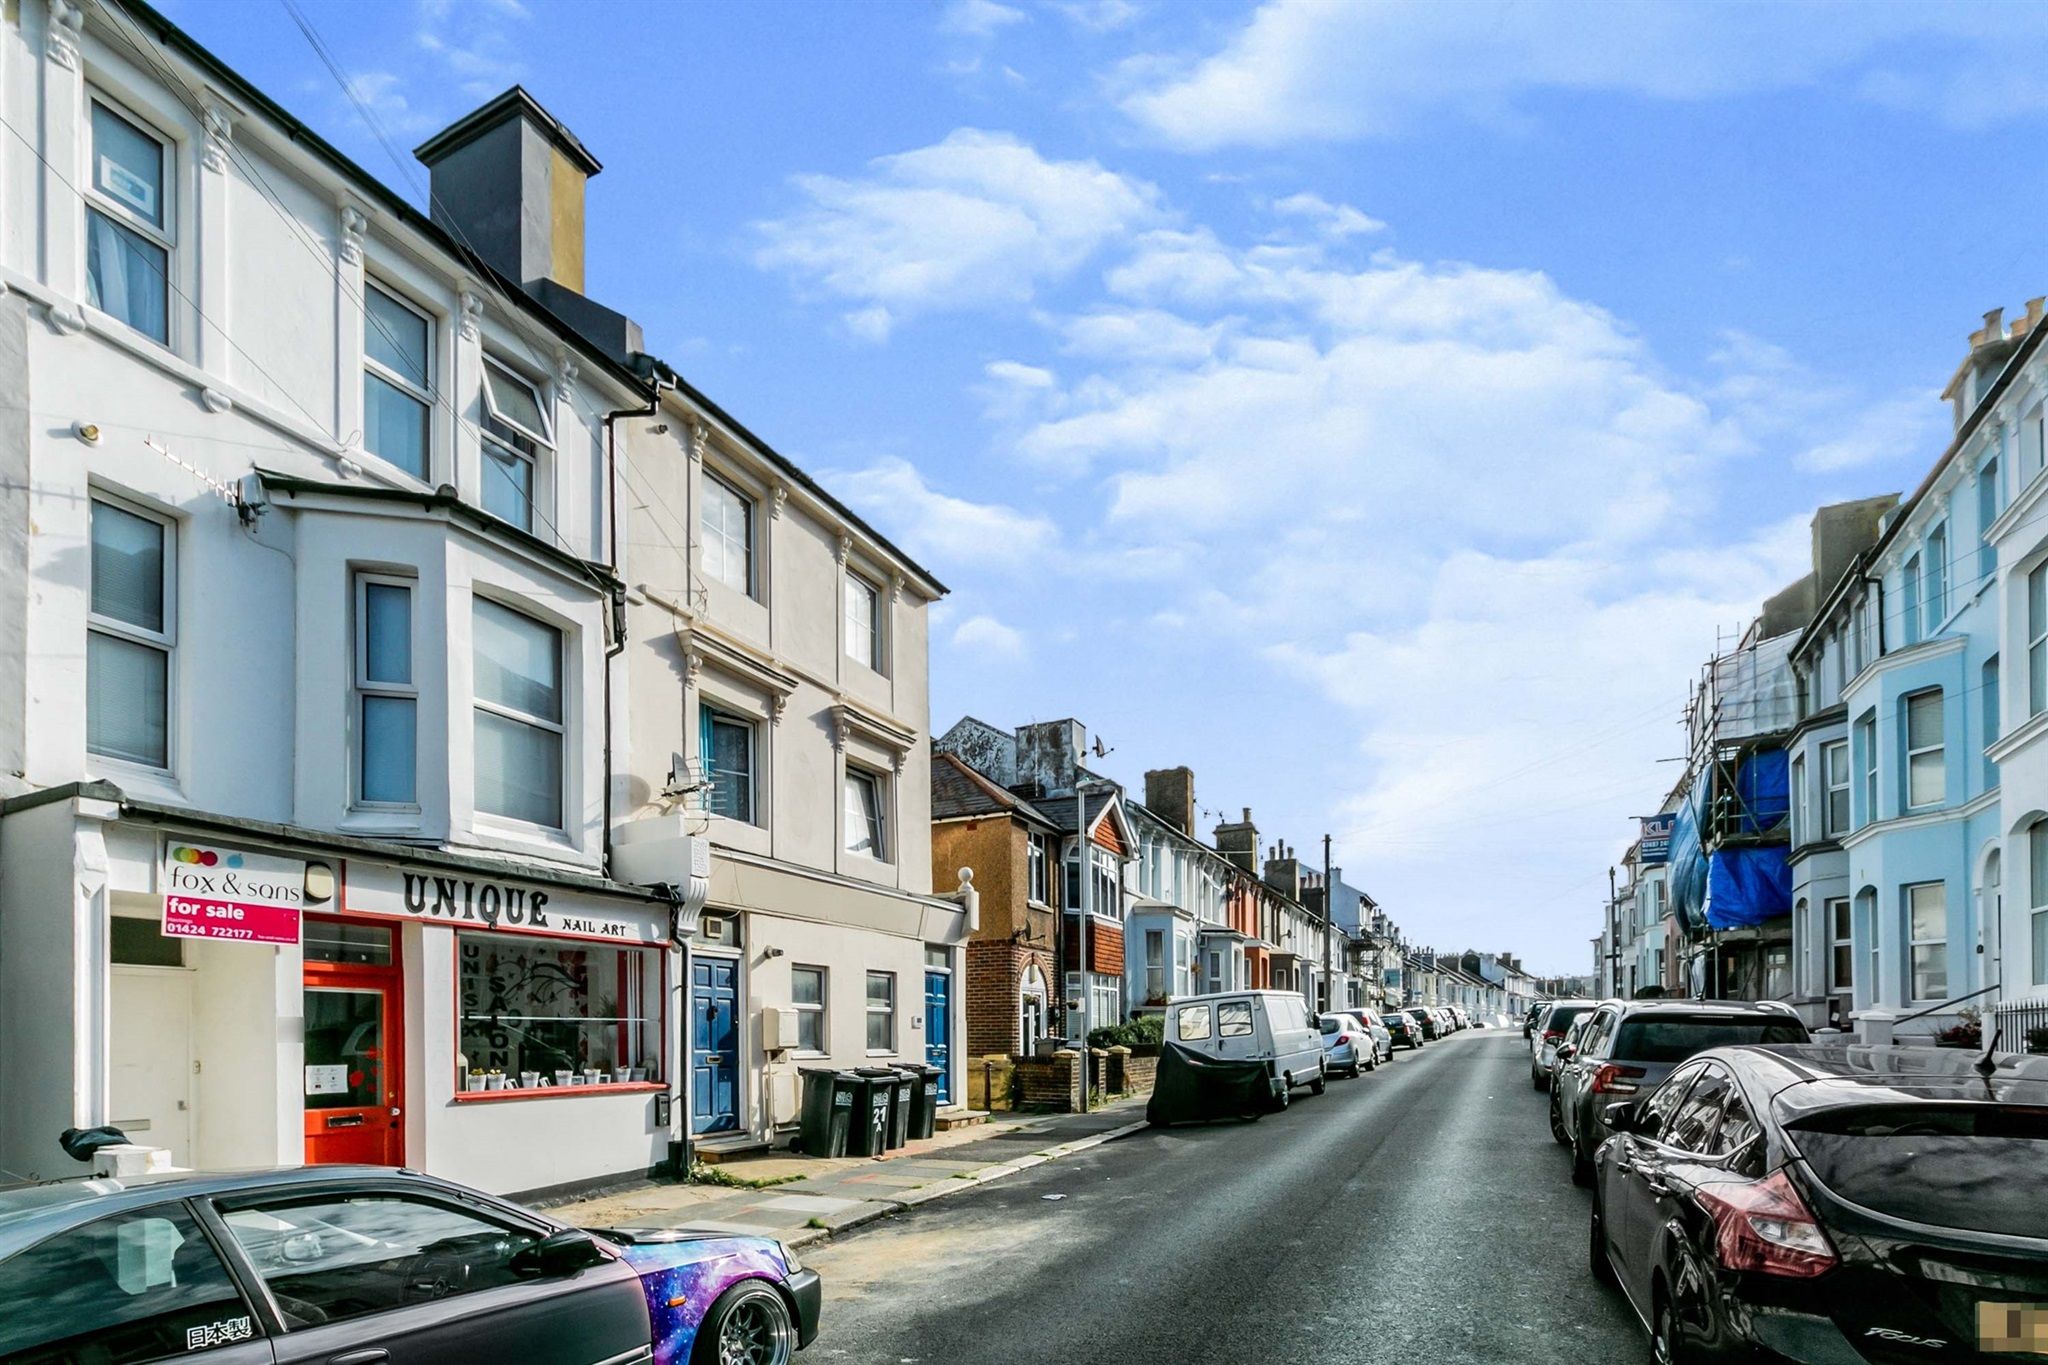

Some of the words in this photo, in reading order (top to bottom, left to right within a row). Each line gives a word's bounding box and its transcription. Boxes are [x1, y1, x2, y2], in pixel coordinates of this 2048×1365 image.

[170, 865, 215, 893] fox
[222, 872, 242, 895] &
[247, 882, 300, 902] sons
[169, 898, 201, 915] for
[205, 903, 245, 920] sale
[402, 872, 549, 930] UNIQUE
[167, 923, 206, 935] 01424
[211, 926, 253, 939] 722177
[562, 918, 596, 933] NAIL
[601, 923, 627, 937] ART
[186, 1315, 253, 1350] 日本製
